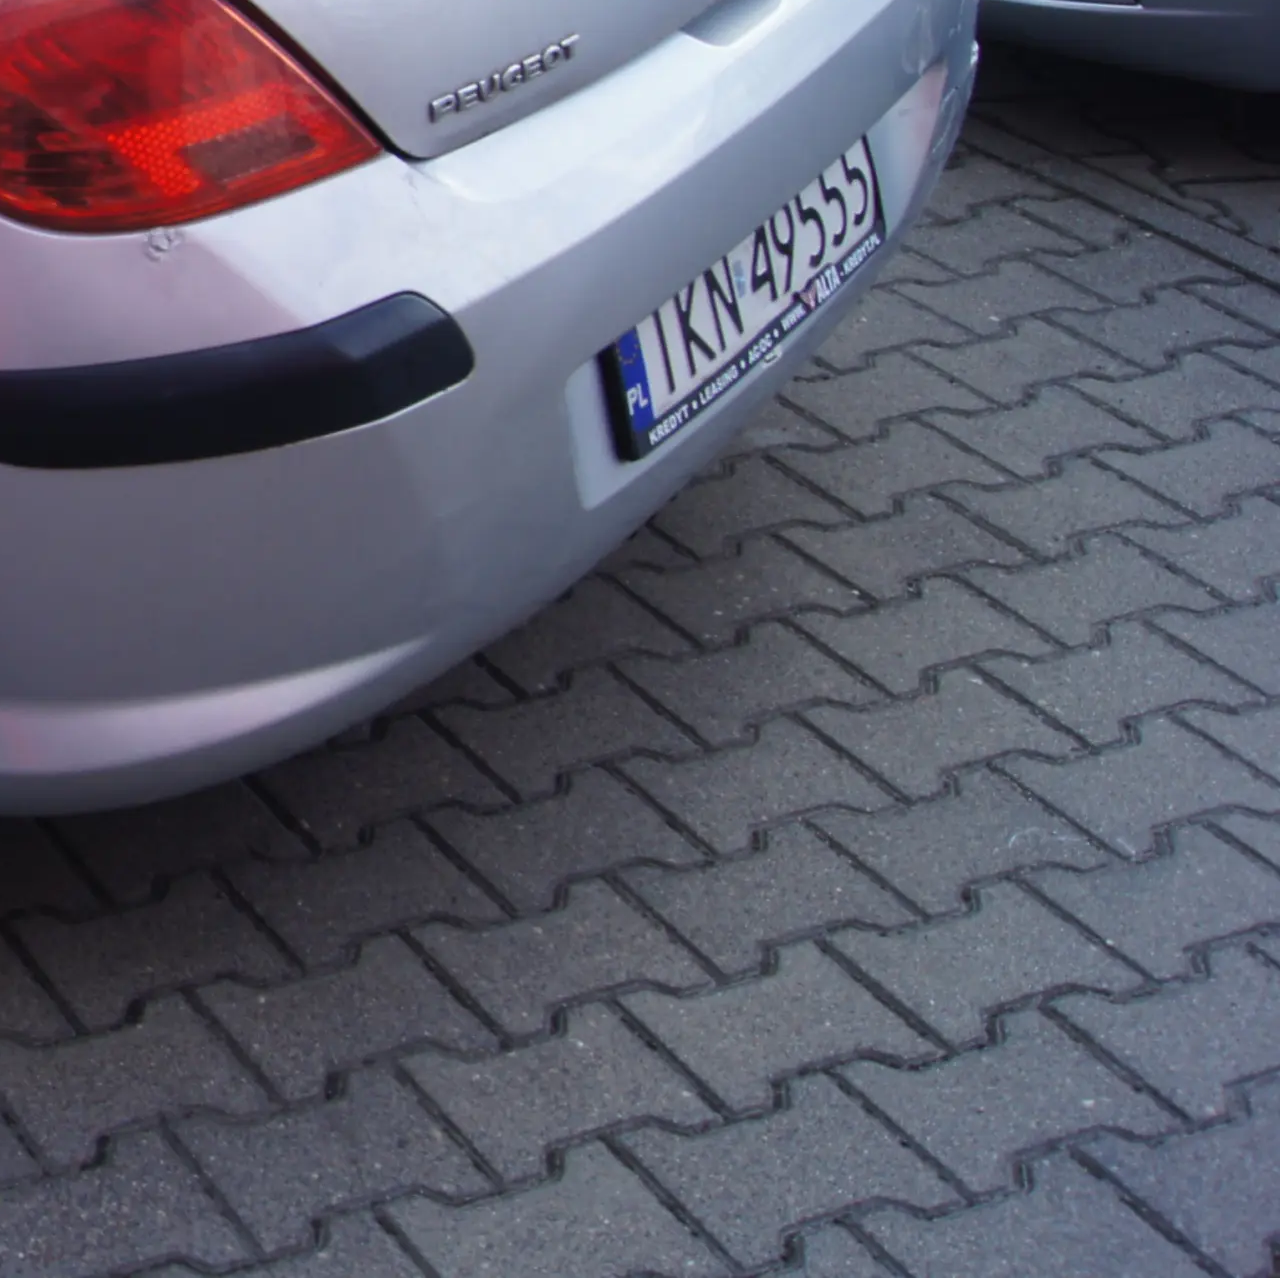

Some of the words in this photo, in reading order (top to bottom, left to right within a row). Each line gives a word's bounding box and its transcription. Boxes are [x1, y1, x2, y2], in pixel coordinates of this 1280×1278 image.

[428, 33, 581, 124] PEUGEOT
[750, 153, 869, 302] 49555
[626, 382, 648, 416] PL
[648, 404, 689, 445] KREDYT
[699, 364, 739, 405] LEASING
